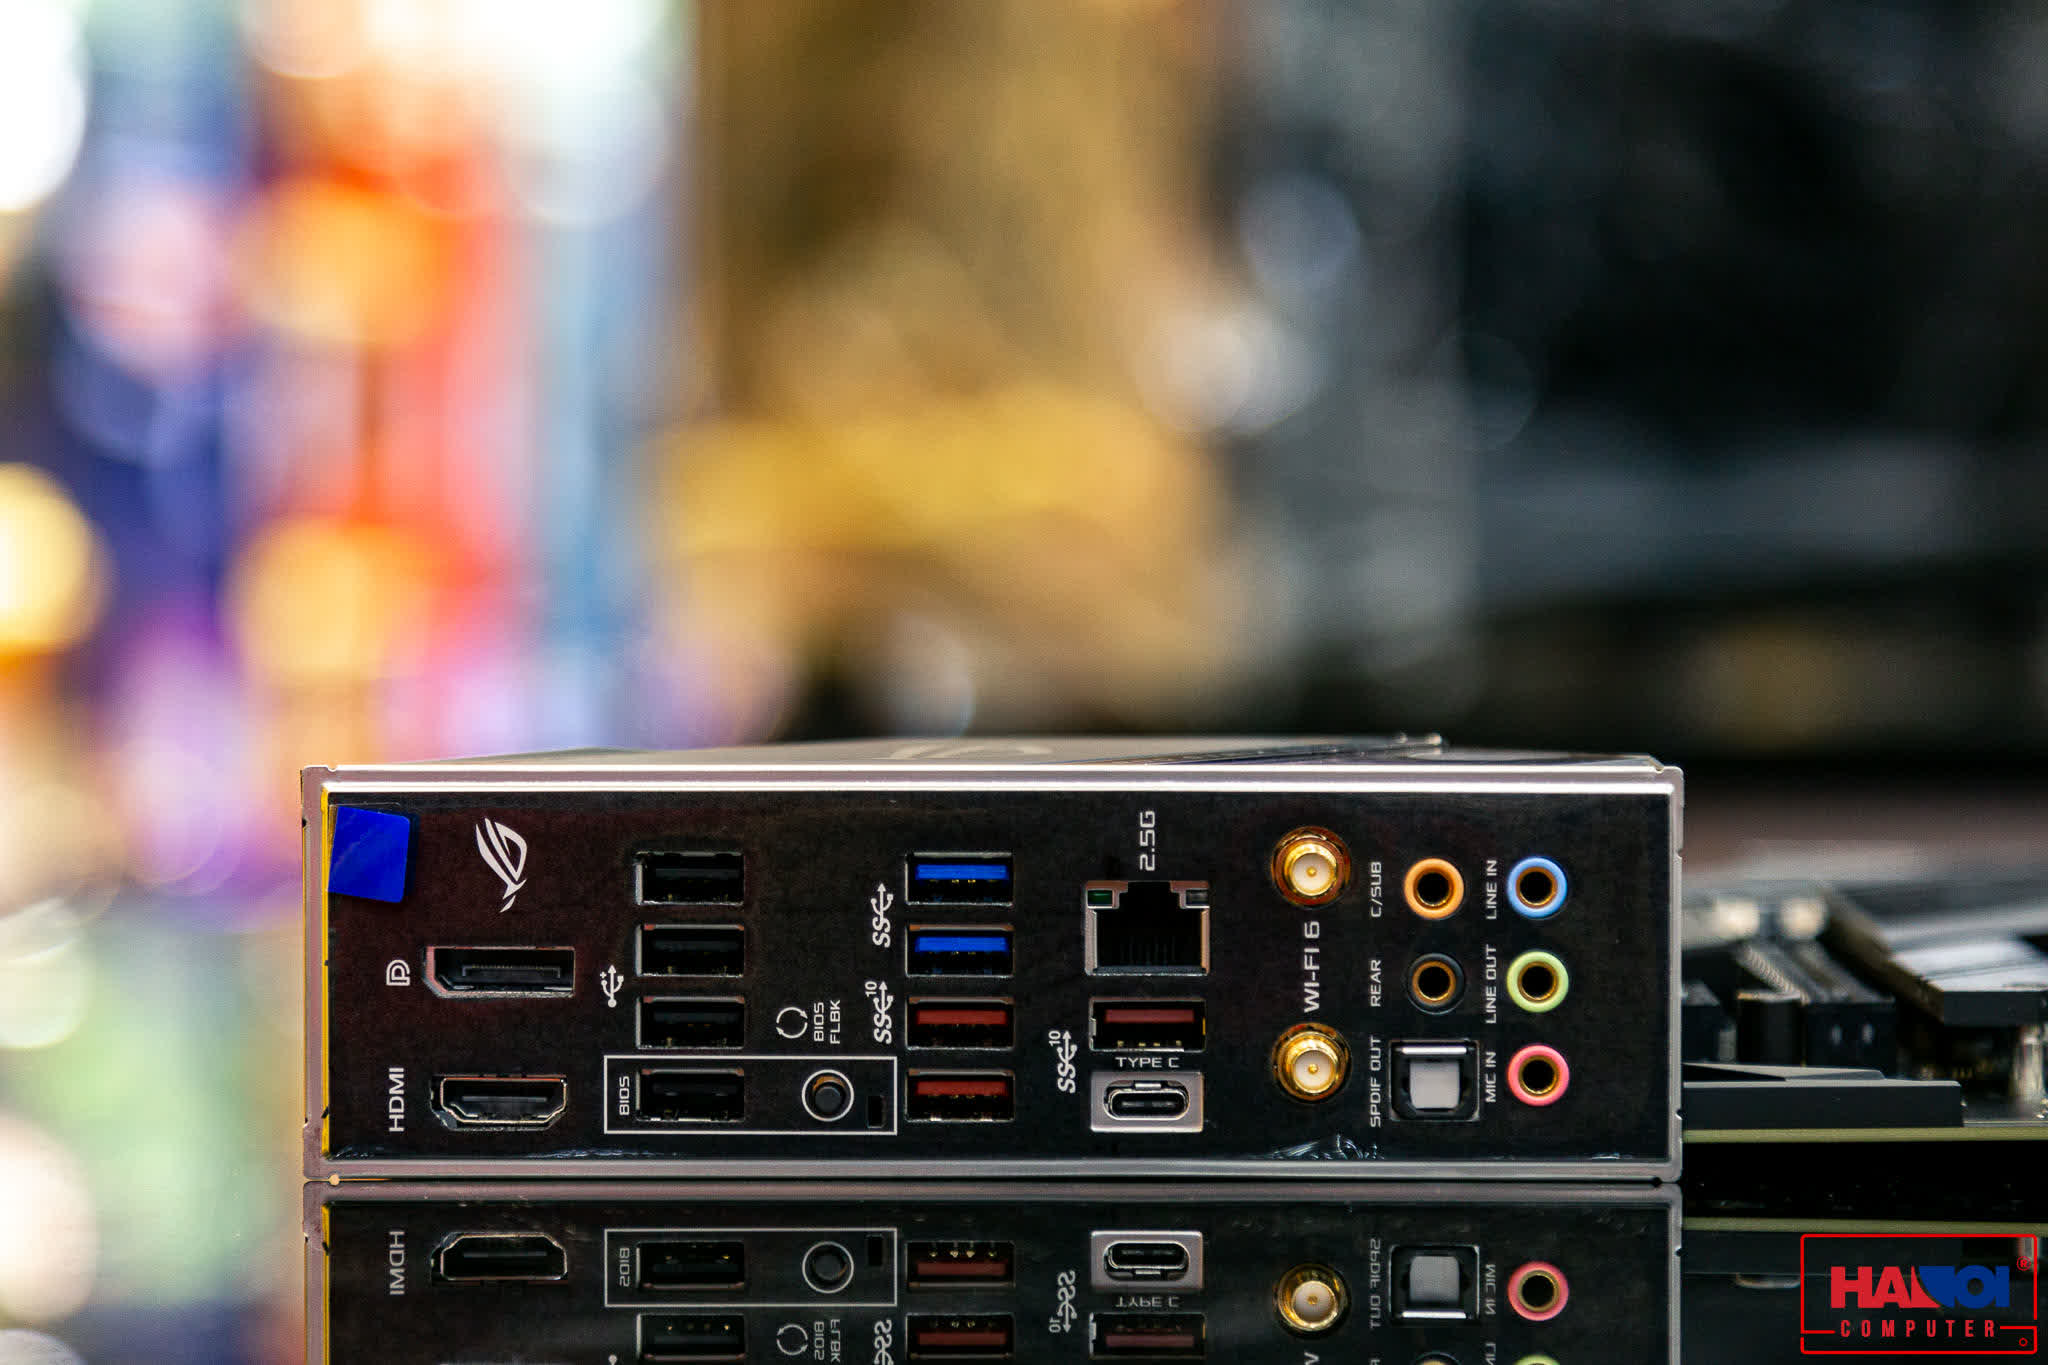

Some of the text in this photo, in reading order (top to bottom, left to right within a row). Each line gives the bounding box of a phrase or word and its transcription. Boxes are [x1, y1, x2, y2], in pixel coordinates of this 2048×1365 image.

[1139, 810, 1156, 872] 2.5G
[1370, 861, 1383, 918] C/SUB
[1486, 859, 1497, 920] LINE IN
[1303, 921, 1320, 1013] WI-FI 6
[1370, 959, 1382, 1007] REAR
[1485, 943, 1497, 1024] LINE OUT
[813, 1001, 825, 1042] BIOS
[829, 999, 841, 1045] FLBK
[1115, 1056, 1180, 1069] TYPE C
[1369, 1035, 1381, 1128] SPDIF OUT
[1485, 1051, 1497, 1103] MIC IN
[388, 1067, 405, 1132] HDMI
[618, 1075, 630, 1116] BIOS
